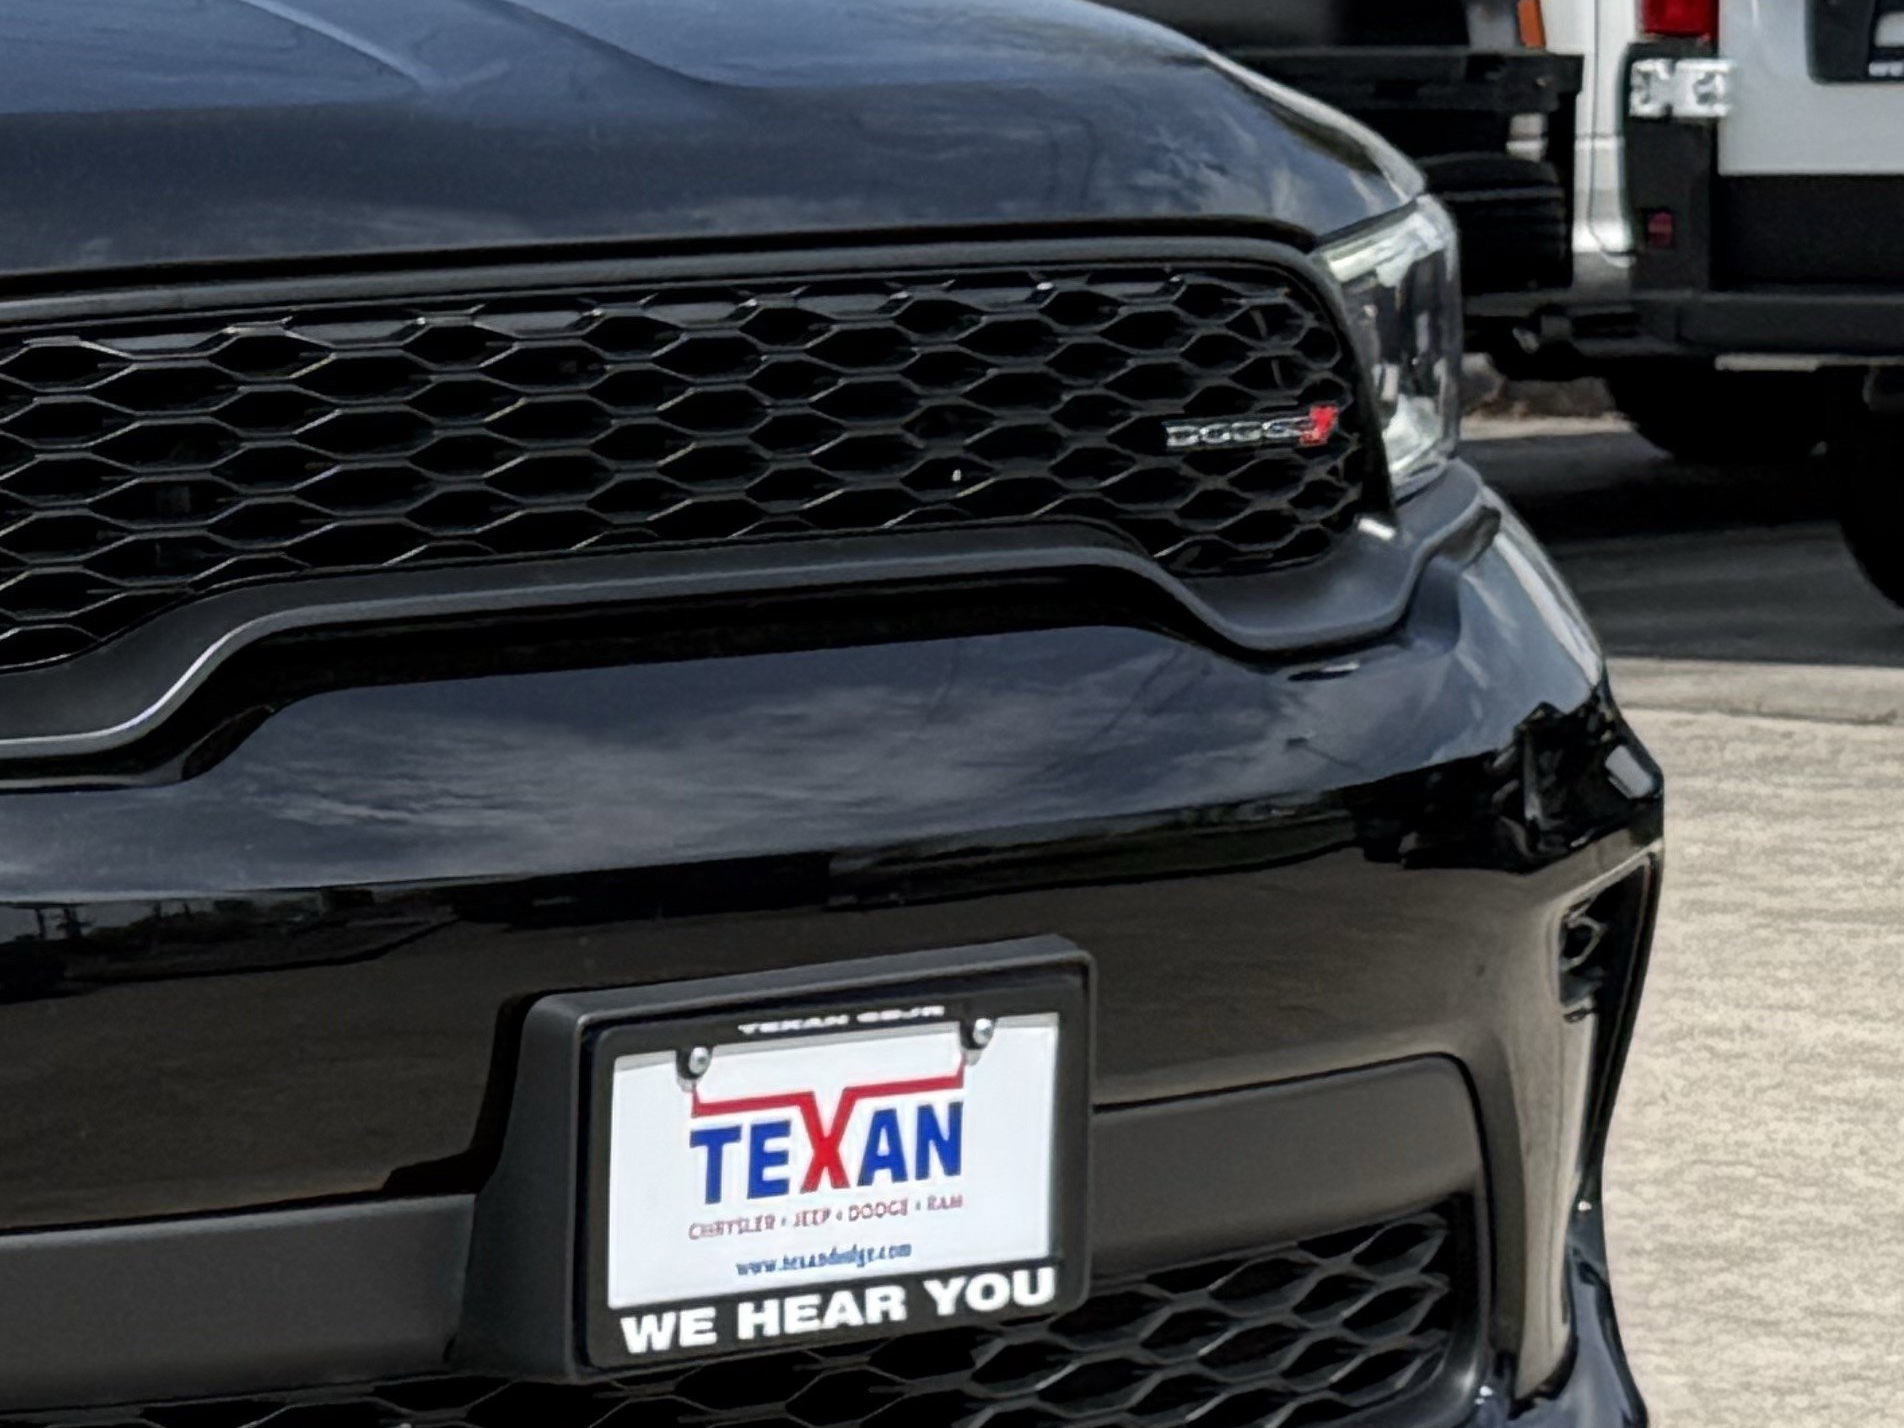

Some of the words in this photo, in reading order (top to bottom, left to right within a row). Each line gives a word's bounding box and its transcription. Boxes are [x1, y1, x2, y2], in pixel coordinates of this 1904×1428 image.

[689, 1084, 963, 1205] TEXAN
[848, 1199, 909, 1222] DODGE
[926, 1194, 964, 1211] RAM
[620, 1307, 716, 1355] WE
[737, 1285, 908, 1340] HEAR
[923, 1266, 1056, 1317] YOU
